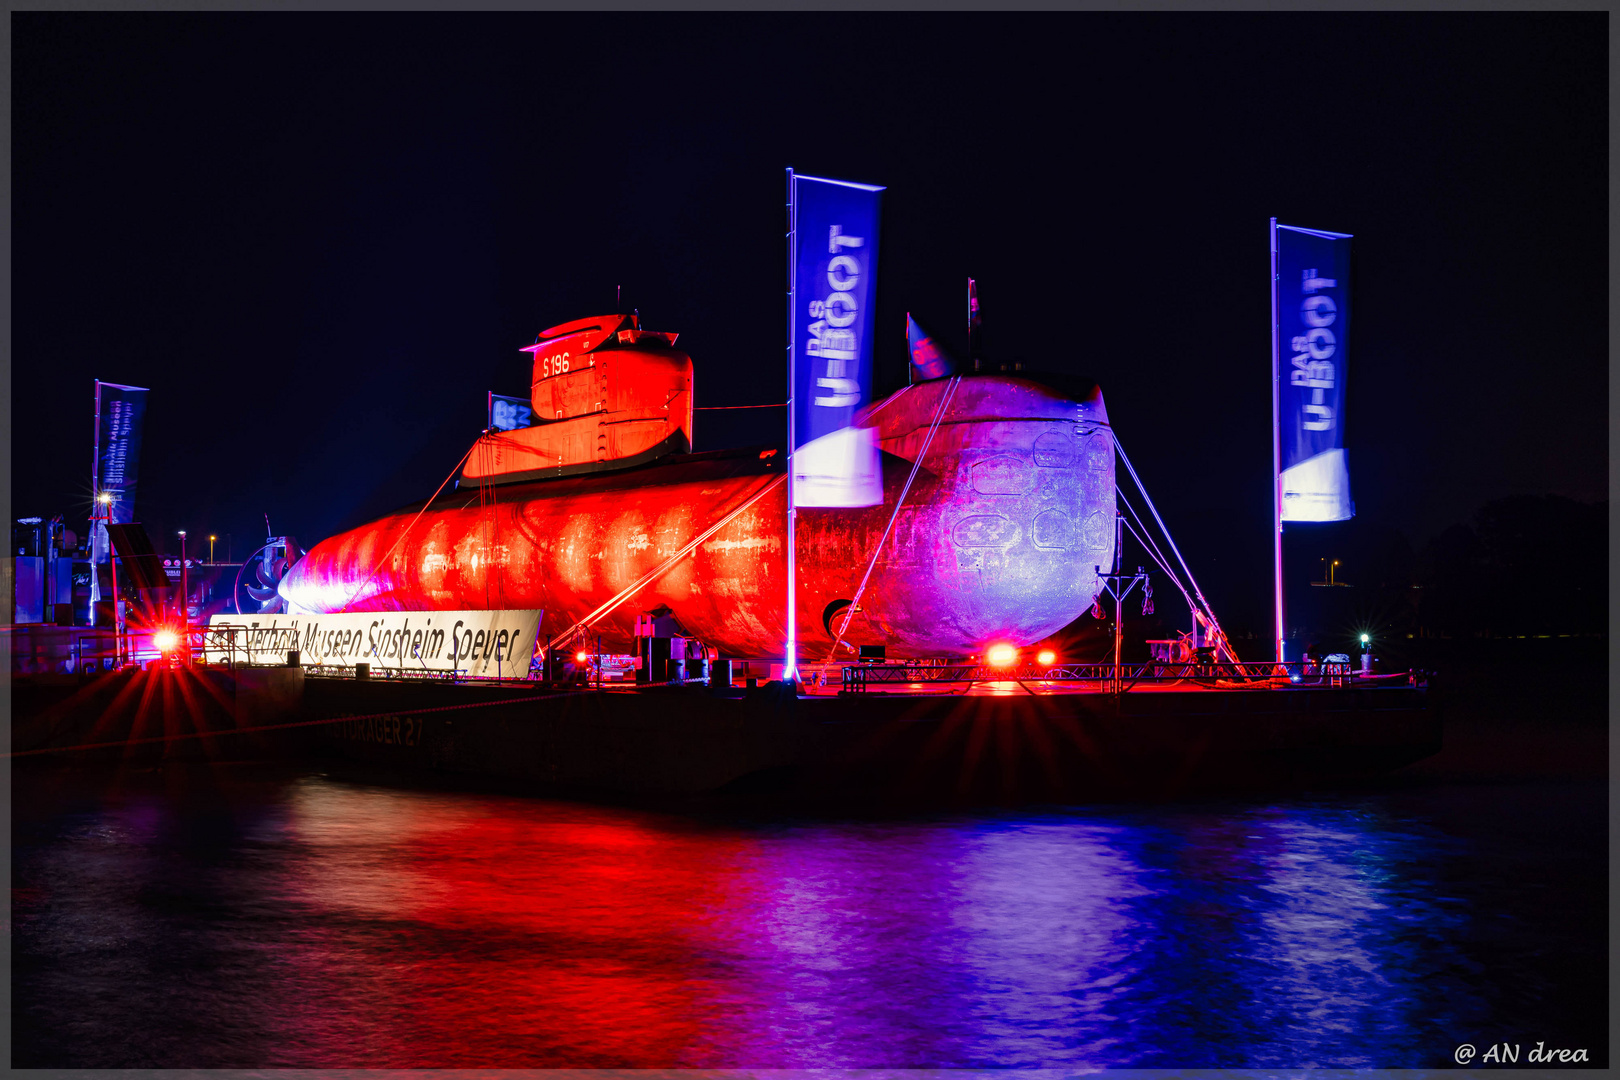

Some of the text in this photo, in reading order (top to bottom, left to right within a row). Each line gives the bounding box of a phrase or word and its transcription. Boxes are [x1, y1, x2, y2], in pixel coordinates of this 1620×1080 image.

[806, 300, 825, 356] DAS
[814, 224, 864, 407] U-BOOT
[1290, 335, 1310, 387] DAS
[1299, 268, 1338, 432] U-BOOT
[109, 400, 122, 441] Museen
[249, 618, 520, 673] Technik Museen Sinsheim Speyer
